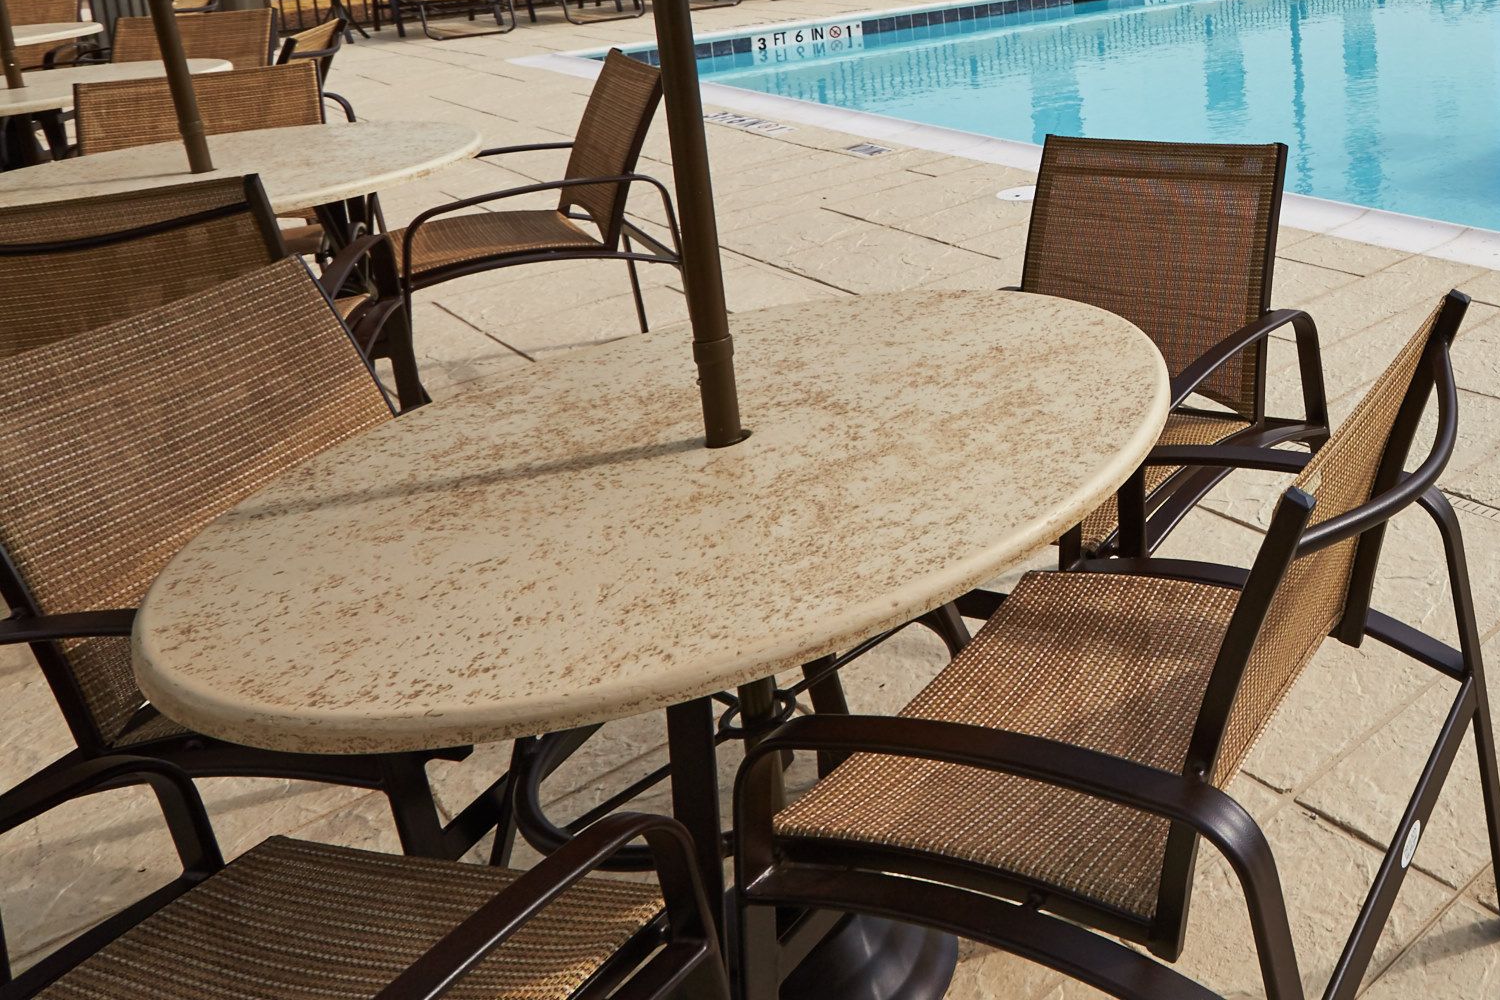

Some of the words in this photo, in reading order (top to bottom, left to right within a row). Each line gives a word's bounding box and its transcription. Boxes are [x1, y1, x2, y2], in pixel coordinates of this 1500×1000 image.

[757, 37, 767, 50] 3
[773, 31, 786, 46] FT
[795, 30, 804, 42] 6
[811, 27, 824, 41] IN
